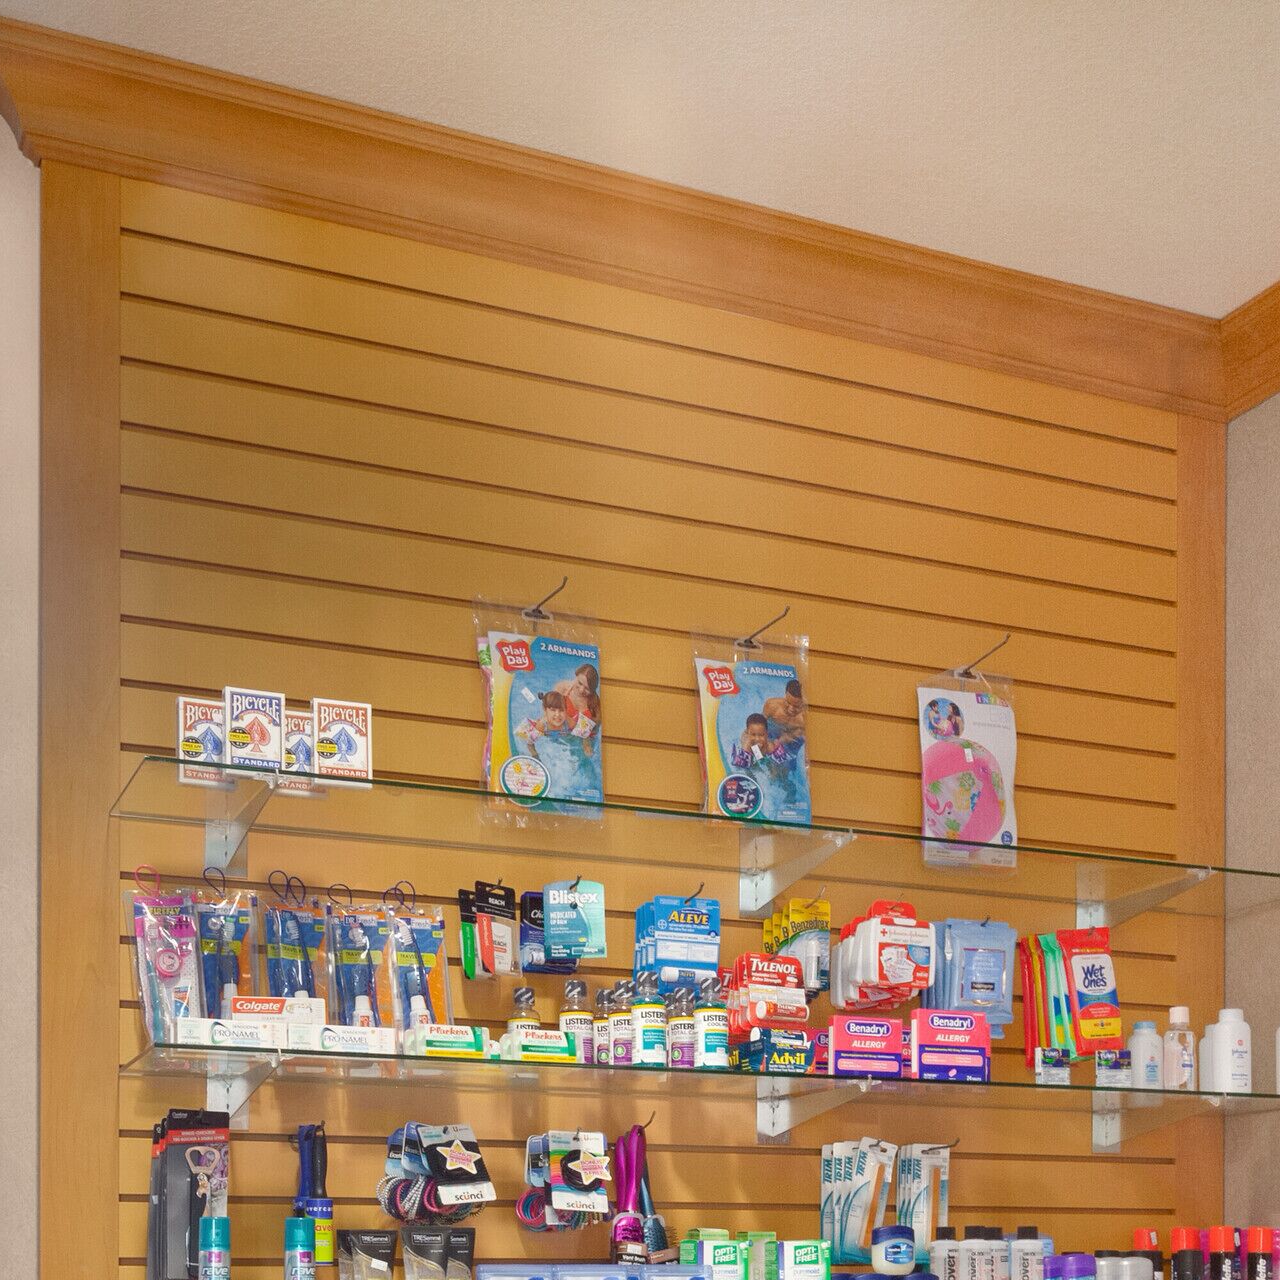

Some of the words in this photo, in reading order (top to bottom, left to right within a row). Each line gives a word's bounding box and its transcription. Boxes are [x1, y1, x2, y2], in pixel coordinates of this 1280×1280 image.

[502, 645, 526, 656] Play
[540, 643, 546, 651] 2
[547, 644, 596, 659] ARMBANDS
[507, 655, 529, 666] Day
[708, 671, 730, 681] Play
[750, 667, 794, 678] ARMBANDS
[713, 680, 734, 690] Day
[232, 693, 281, 725] BICYCLE
[320, 705, 367, 732] BICYCLE
[232, 757, 281, 769] STANDARD
[321, 767, 368, 778] STANDARD
[549, 890, 599, 906] Blistex
[669, 910, 710, 925] ALEVE
[750, 958, 796, 974] TYLENOL
[1082, 964, 1105, 978] Wet
[1083, 976, 1107, 989] Ones
[235, 1000, 281, 1012] Colgate
[933, 1016, 971, 1029] Benadryl
[849, 1023, 888, 1036] Benadryl
[851, 1040, 886, 1049] ALLERGY
[936, 1034, 970, 1043] ALLERGY
[769, 1052, 806, 1066] Advil
[455, 1190, 484, 1202] scünci
[566, 1200, 595, 1210] scünci
[715, 1254, 737, 1264] FREE
[795, 1254, 818, 1264] FREE
[202, 1266, 228, 1276] rave
